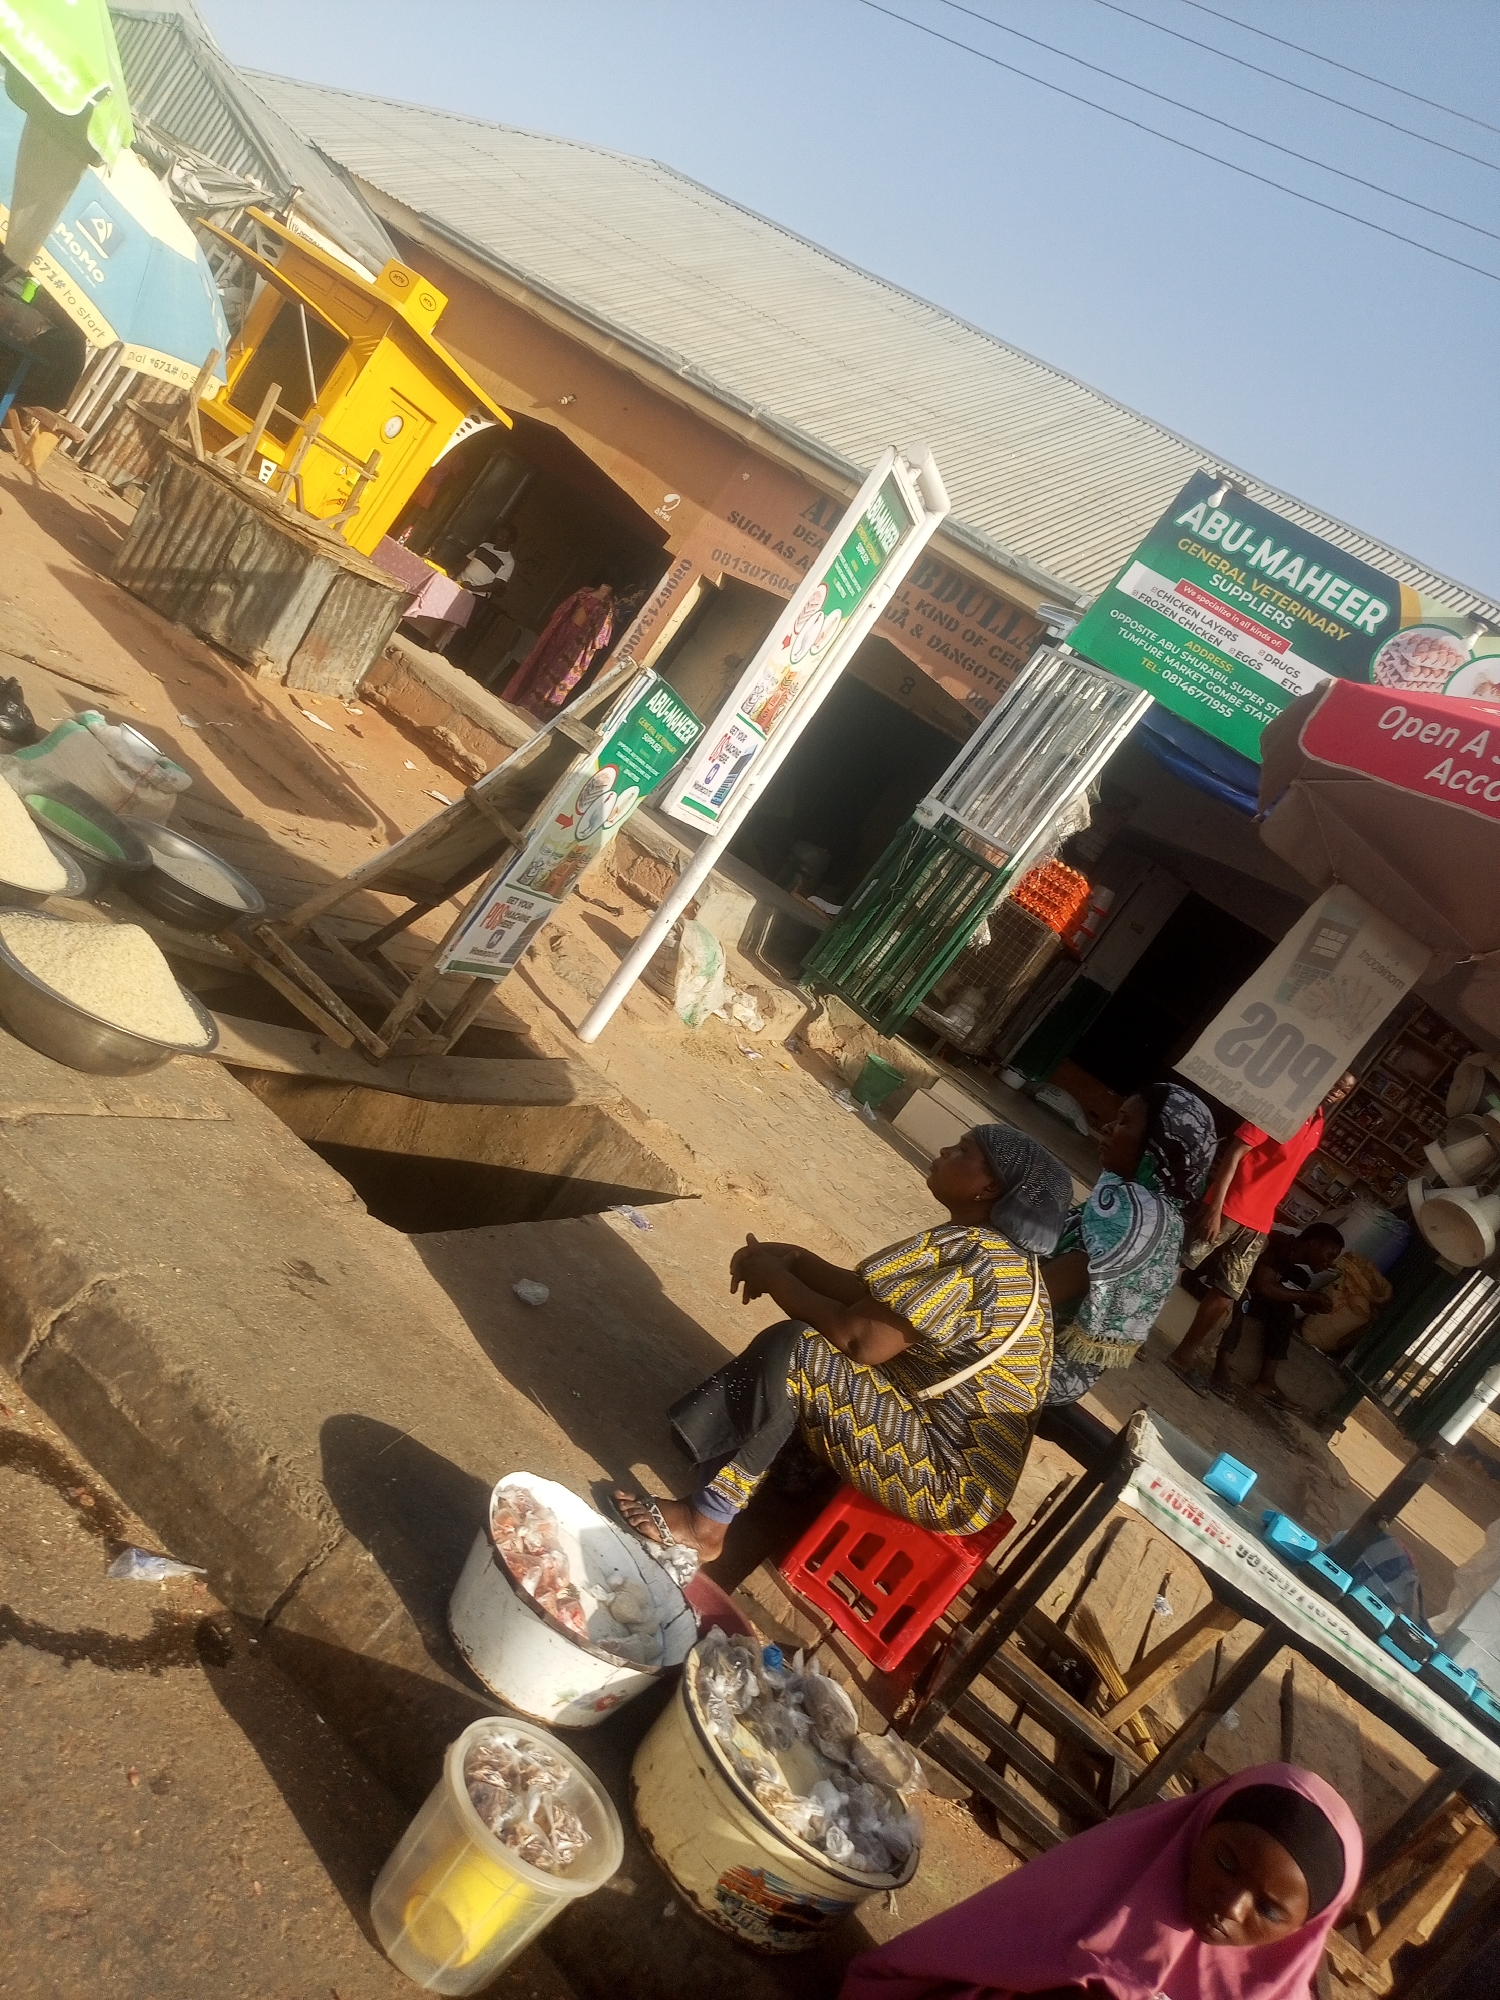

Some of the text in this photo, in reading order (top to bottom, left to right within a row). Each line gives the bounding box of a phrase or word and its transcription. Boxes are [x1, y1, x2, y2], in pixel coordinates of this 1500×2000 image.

[63, 289, 77, 305] to
[76, 307, 106, 338] start
[653, 507, 672, 522] airtel
[1175, 501, 1389, 636] ABU-MAHEER
[1177, 538, 1352, 642] GENERAL VETERINARY
[727, 510, 772, 546] SUCH
[772, 539, 797, 560] AS
[795, 555, 815, 571] A
[909, 623, 924, 639] &
[925, 635, 1010, 693] DANGOTE
[914, 598, 960, 633] KIND
[961, 628, 988, 649] OF
[1183, 585, 1283, 648] We specialize in all kinds of:
[1209, 573, 1296, 631] SUPPLIERS
[1109, 609, 1158, 642] OPPOSITE
[1156, 638, 1181, 655] ABU
[1179, 652, 1229, 687] SHURABIL
[1229, 681, 1266, 707] SUPER
[1138, 592, 1303, 696] FROZEN CHICKEN EGGS ETC.
[1156, 589, 1300, 679] CHICKEN LAYERS DRUGS
[1183, 640, 1235, 674] ADDRESS:
[901, 676, 916, 695] 8
[1117, 627, 1163, 660] TUMFURE
[1163, 655, 1206, 686] MARKET
[1205, 681, 1244, 709] GOMBE
[1140, 657, 1235, 719] TEL: 08146771955
[645, 688, 699, 745] ABU-MAHEER
[1377, 705, 1491, 759] Open A
[479, 902, 511, 931] POS
[506, 895, 520, 906] GET
